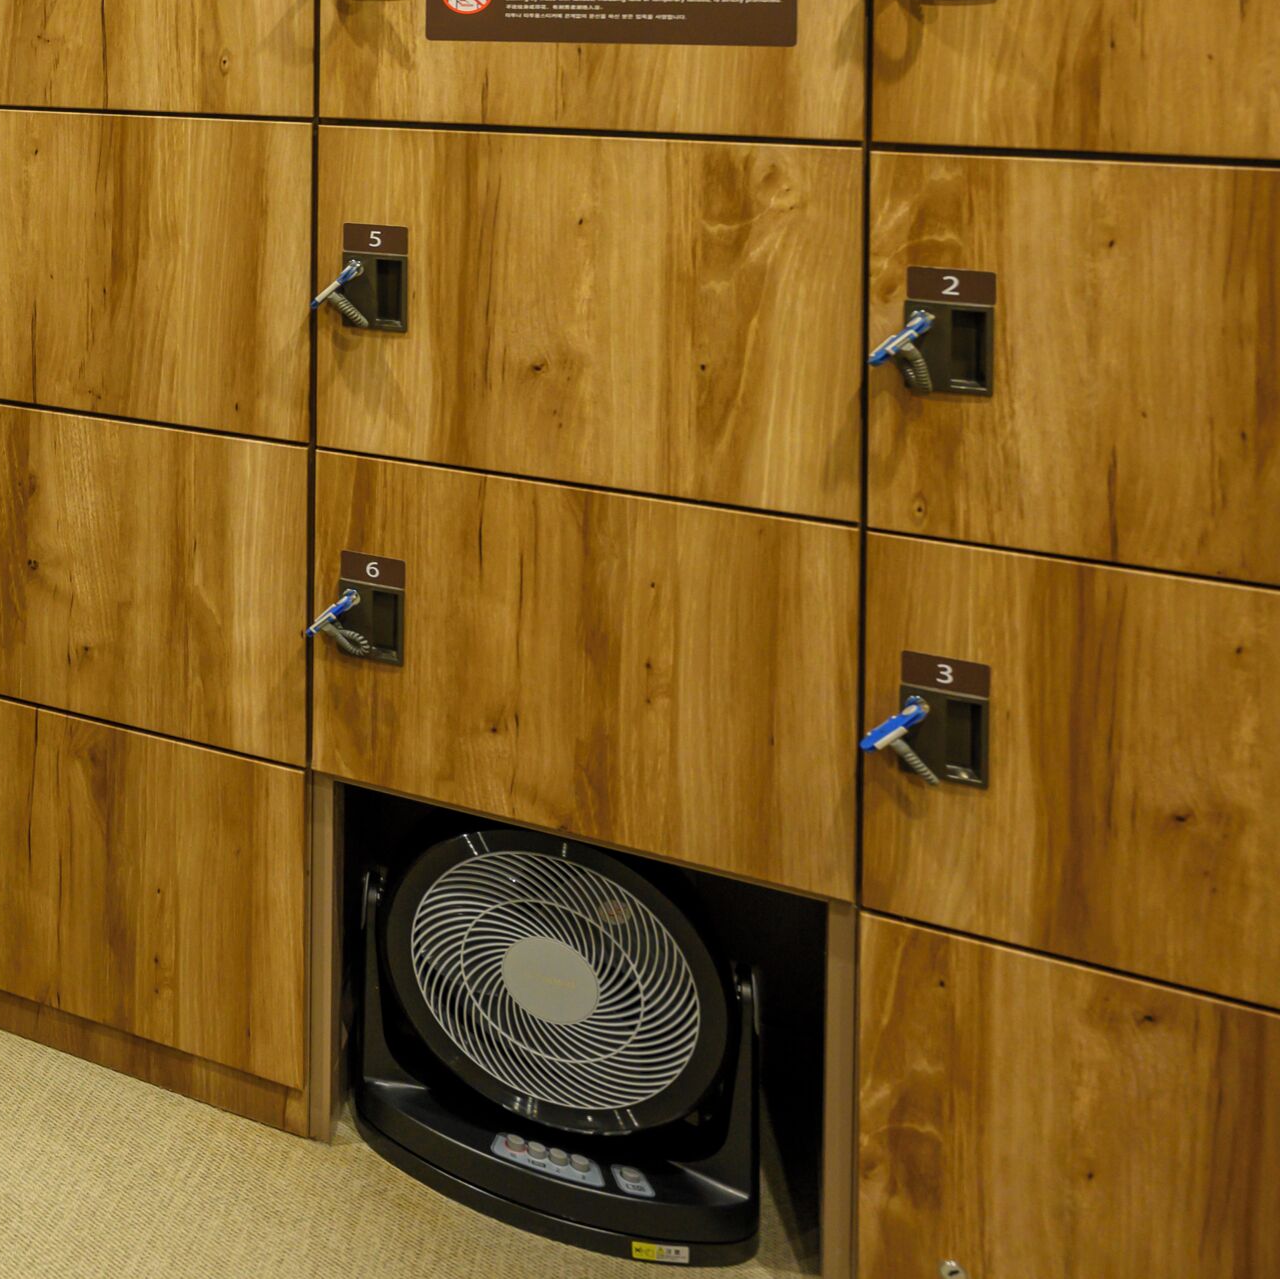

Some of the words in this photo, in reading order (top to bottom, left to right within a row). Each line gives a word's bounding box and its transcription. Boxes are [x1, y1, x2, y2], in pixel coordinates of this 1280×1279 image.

[368, 230, 382, 248] 5
[941, 275, 960, 296] 2
[365, 561, 380, 578] 6
[935, 663, 954, 684] 3
